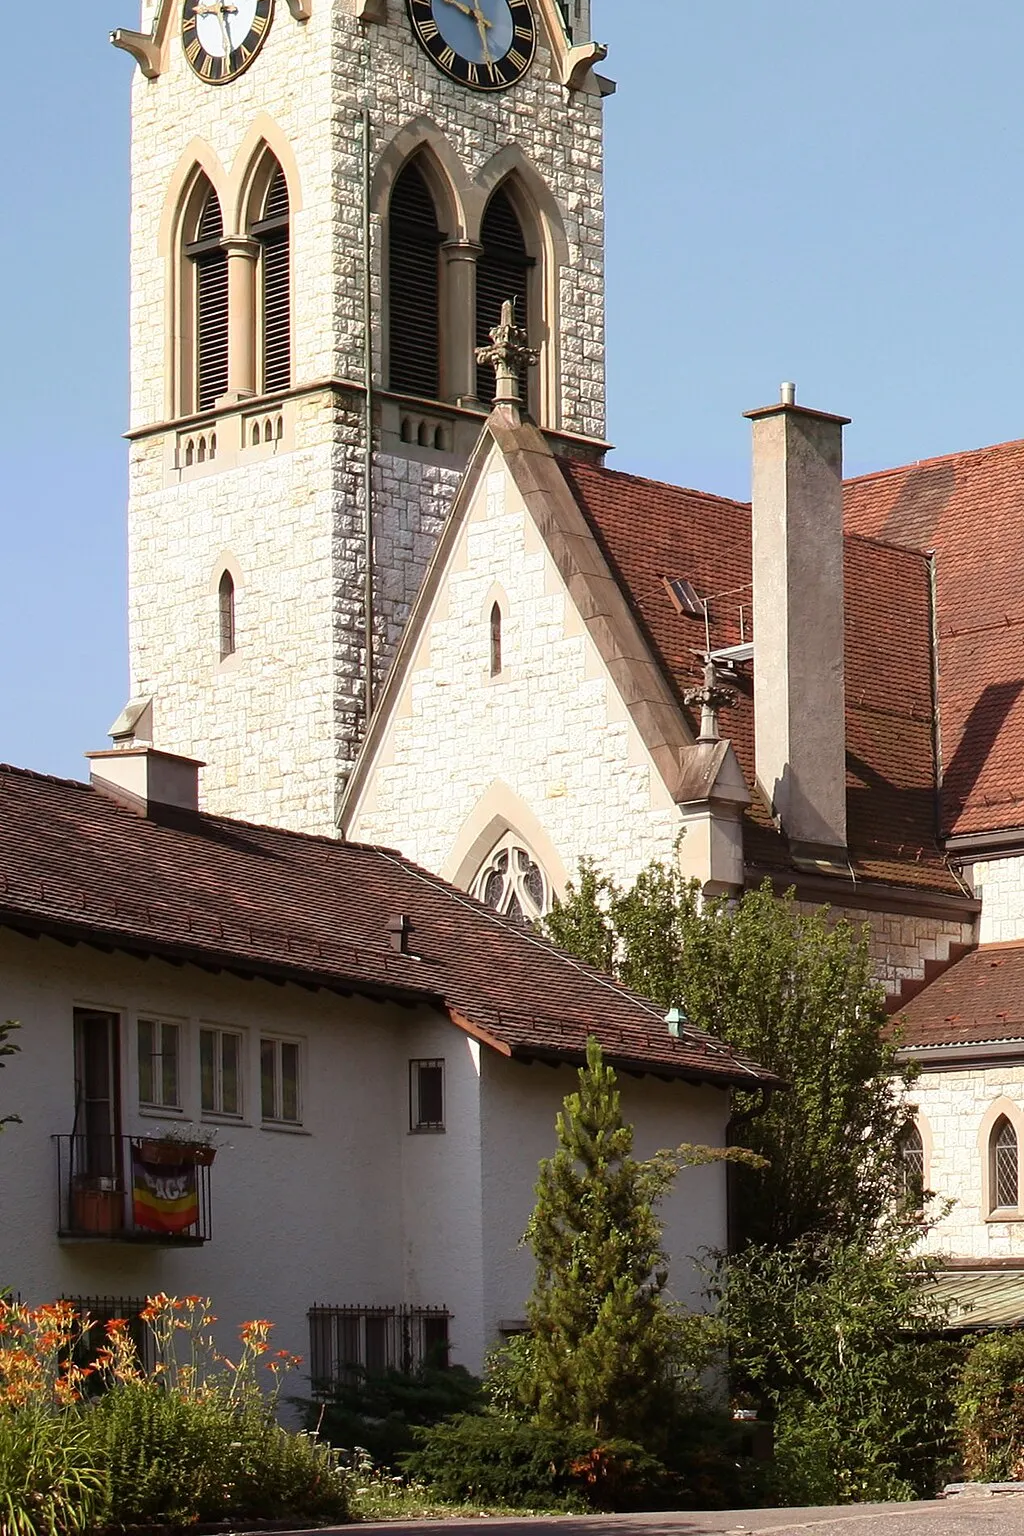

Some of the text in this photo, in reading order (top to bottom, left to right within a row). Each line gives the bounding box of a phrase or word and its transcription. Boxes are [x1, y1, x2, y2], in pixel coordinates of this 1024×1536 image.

[251, 16, 267, 35] IIII
[418, 20, 438, 42] VIII
[514, 25, 533, 42] III
[438, 47, 456, 70] VII
[507, 48, 527, 71] IIII
[467, 62, 480, 85] VI
[494, 64, 508, 85] V
